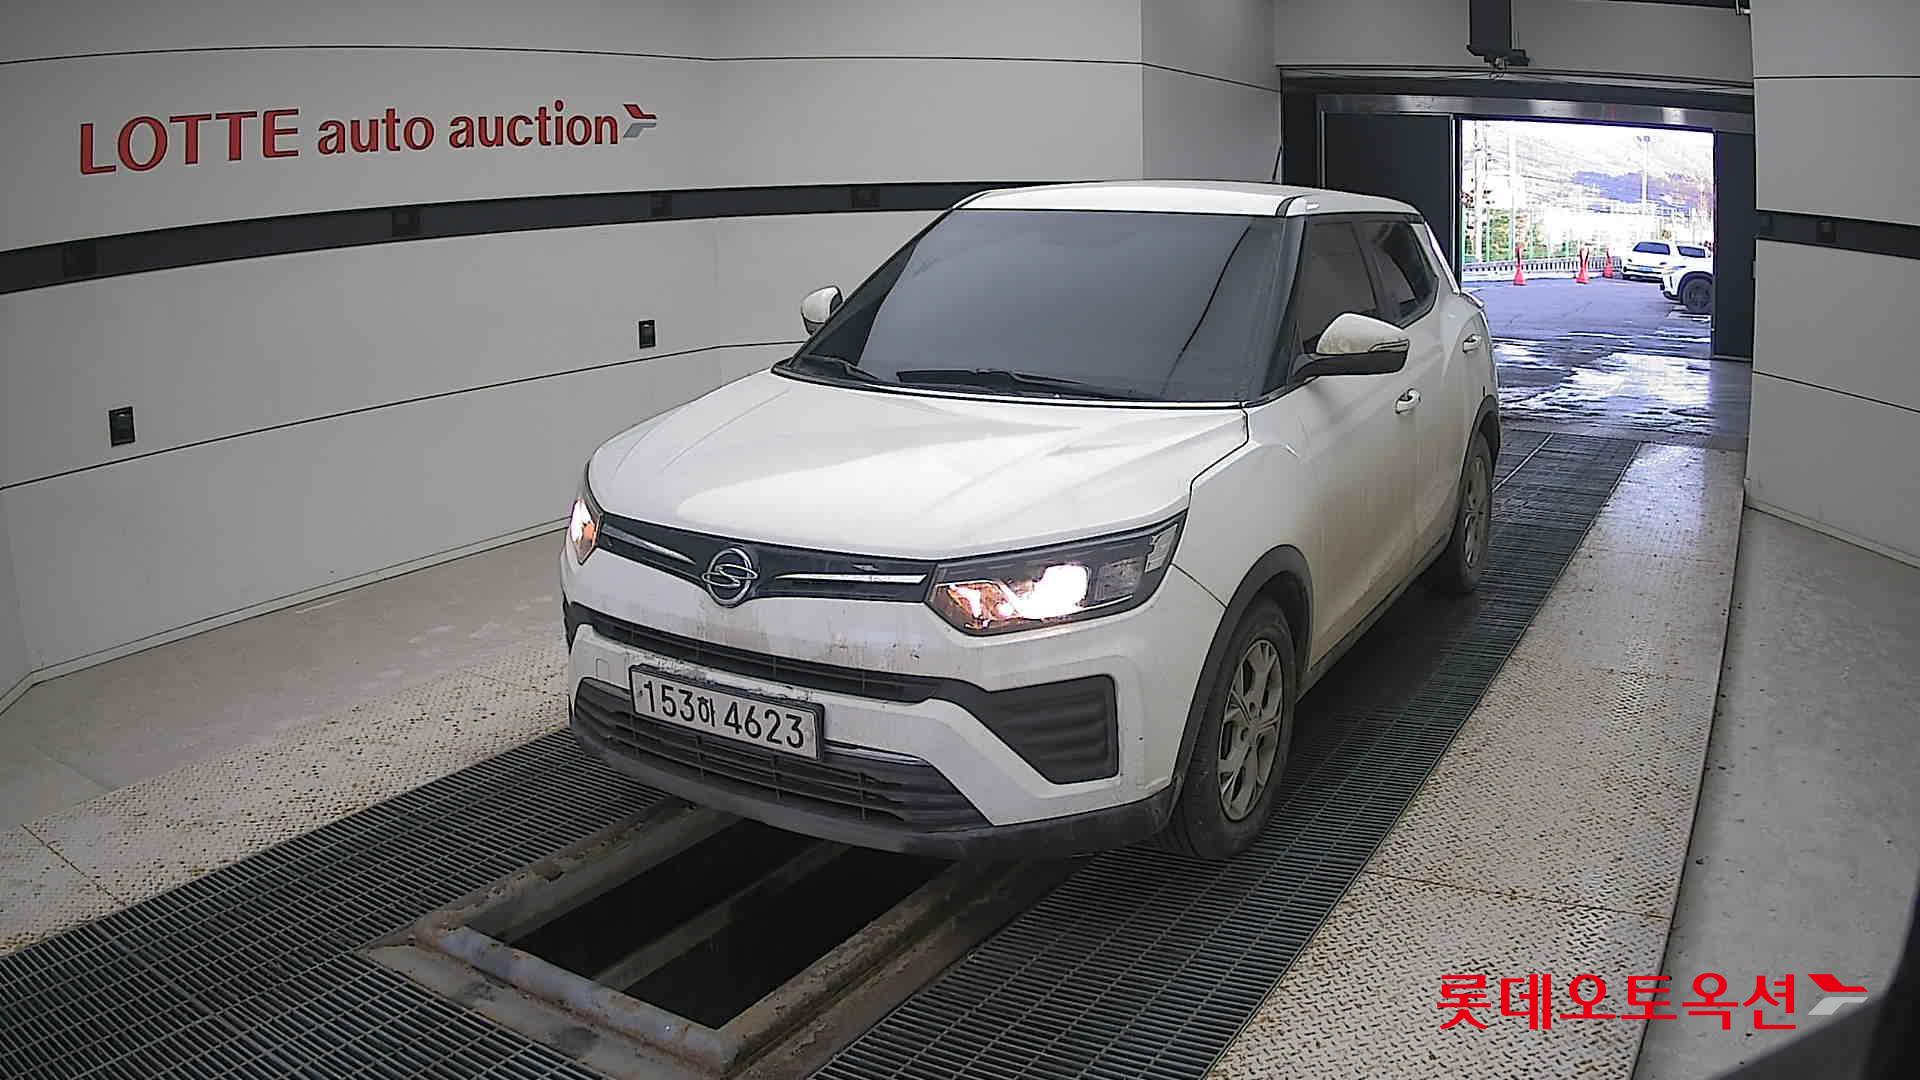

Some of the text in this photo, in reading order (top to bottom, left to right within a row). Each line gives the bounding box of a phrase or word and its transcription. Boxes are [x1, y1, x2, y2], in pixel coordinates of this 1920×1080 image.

[79, 99, 619, 175] LOTTE auto auction
[643, 680, 804, 748] 153하 4623
